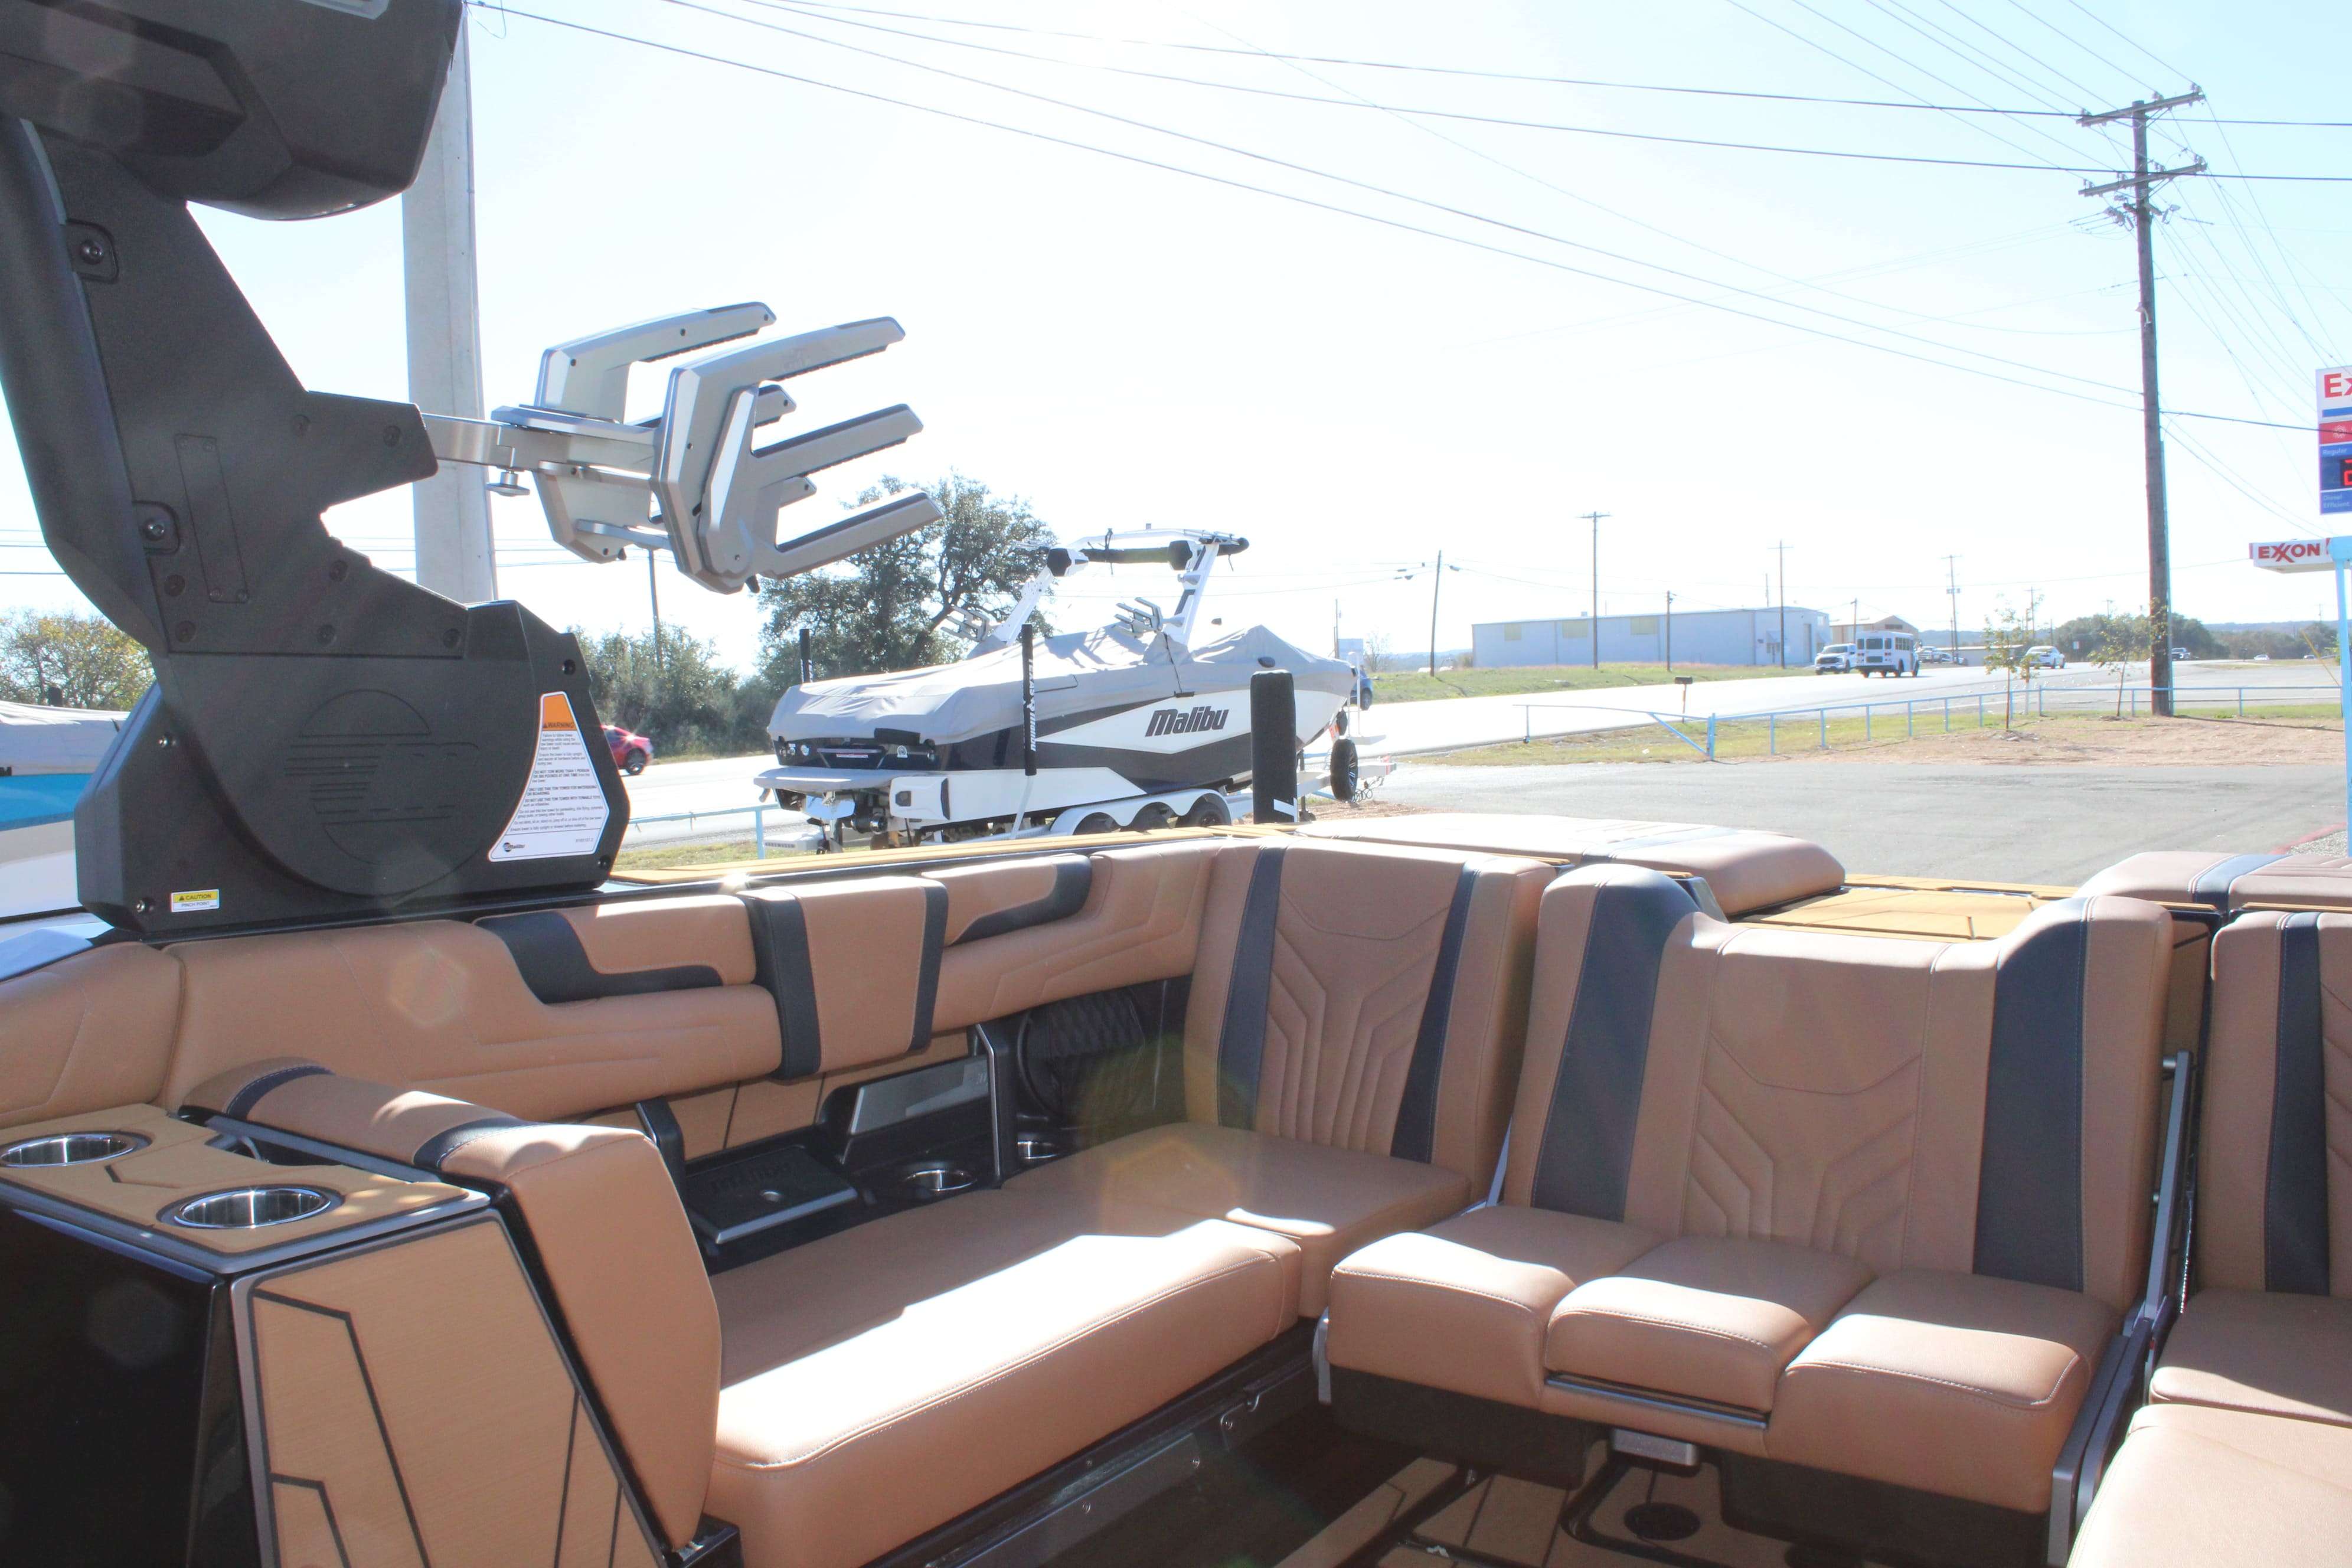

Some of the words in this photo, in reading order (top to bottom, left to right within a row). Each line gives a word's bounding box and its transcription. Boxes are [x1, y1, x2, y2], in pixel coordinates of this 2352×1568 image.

[2322, 447, 2348, 456] Regular
[2258, 543, 2320, 563] EXXON
[1144, 705, 1230, 737] Malibu
